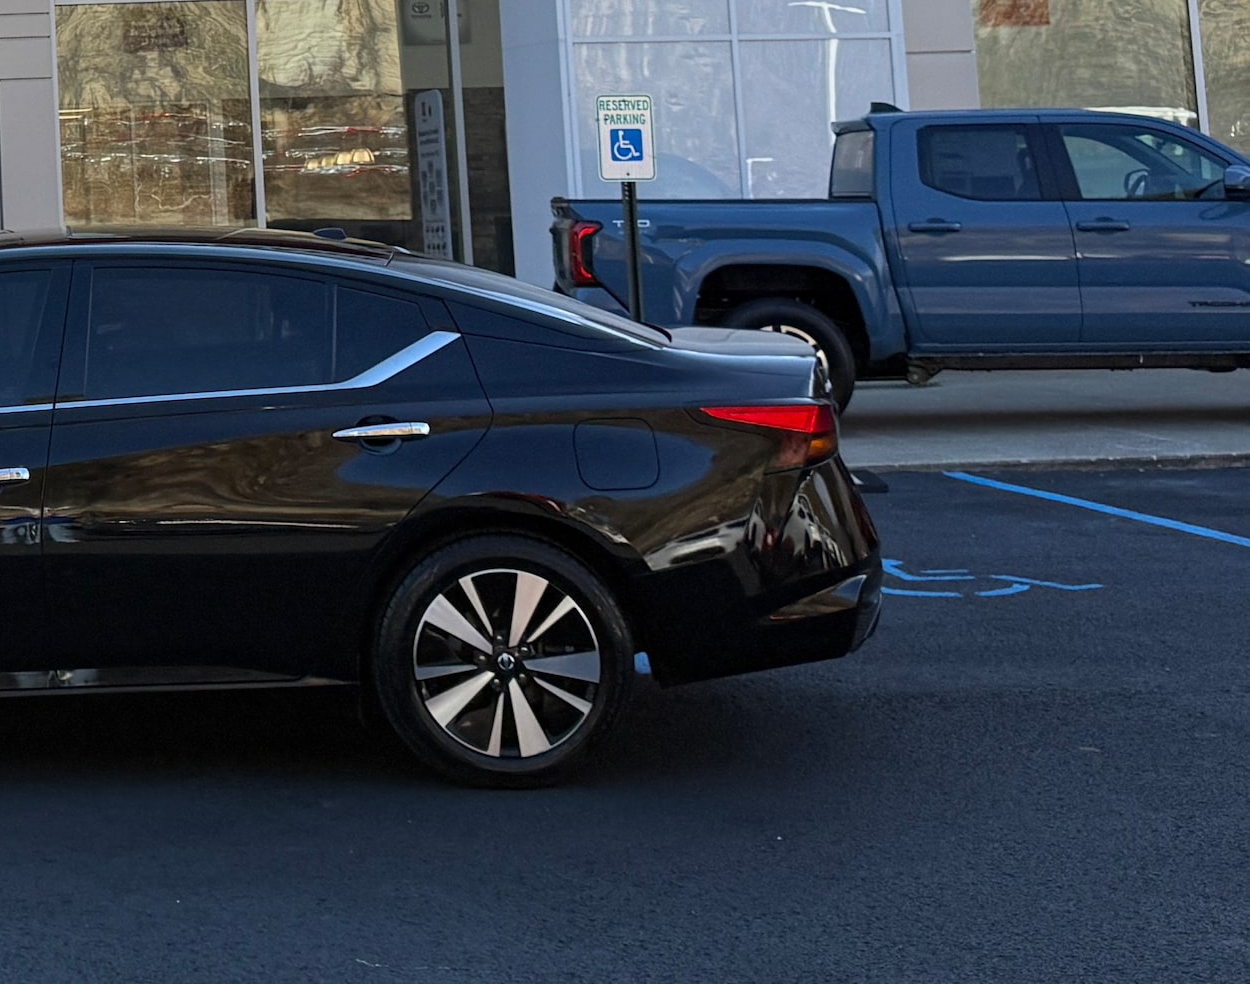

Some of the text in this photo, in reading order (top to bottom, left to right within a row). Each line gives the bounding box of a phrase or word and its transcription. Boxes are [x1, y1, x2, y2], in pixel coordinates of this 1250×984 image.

[599, 99, 649, 111] RESERVED
[604, 113, 646, 125] PARKING
[612, 219, 650, 228] TD
